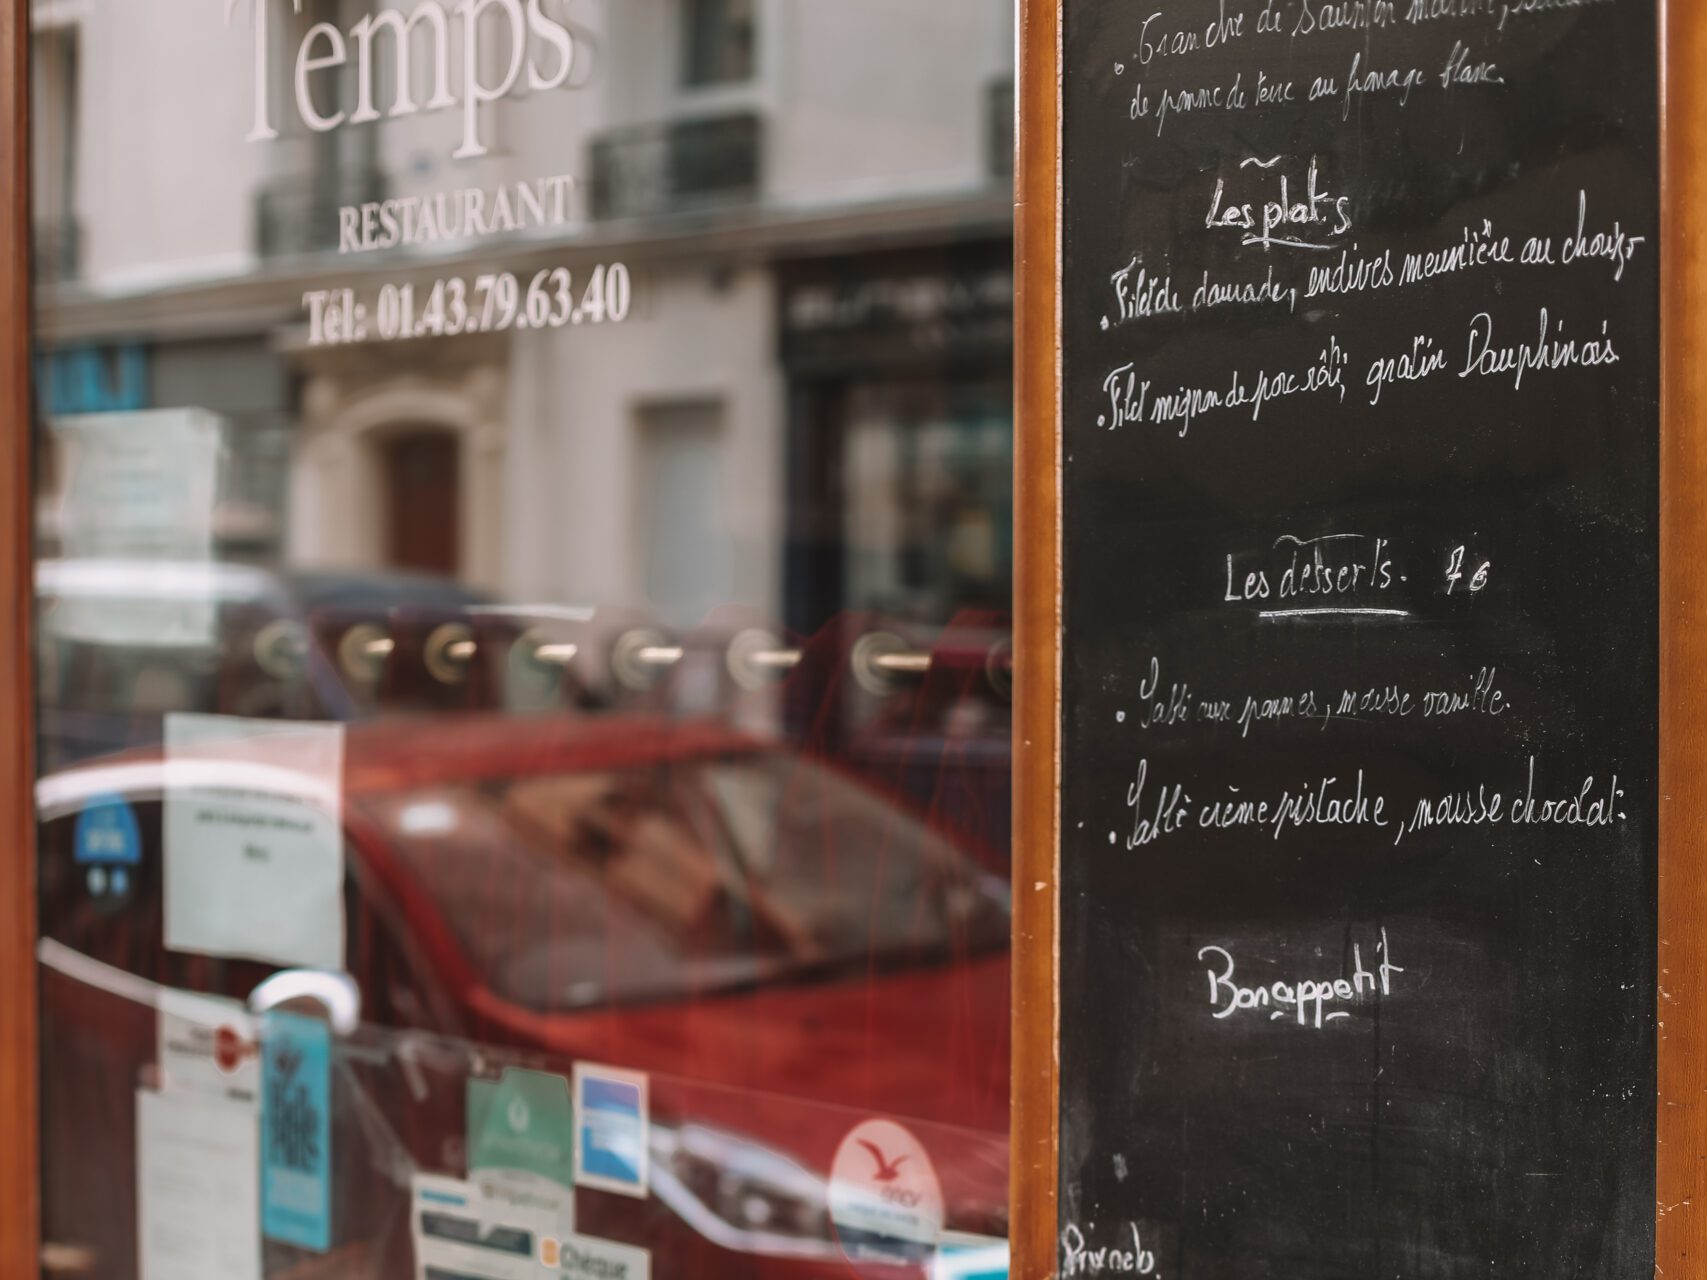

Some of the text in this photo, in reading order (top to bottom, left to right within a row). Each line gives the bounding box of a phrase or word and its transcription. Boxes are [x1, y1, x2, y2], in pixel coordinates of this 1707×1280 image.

[1256, 0, 1282, 33] de
[222, 0, 573, 159] Temps
[1130, 83, 1149, 120] de
[1226, 73, 1246, 110] de
[1308, 76, 1338, 101] au
[339, 174, 574, 254] RESTAURANT
[1205, 153, 1352, 251] Les plats
[377, 262, 631, 339] 01.43.79.63.40
[1304, 243, 1394, 297] endives
[1520, 237, 1555, 265] au
[1103, 362, 1150, 430] Filet
[1150, 386, 1222, 438] mignon
[1225, 370, 1249, 408] de
[1249, 370, 1300, 422] porc
[1366, 335, 1448, 406] gratin
[1224, 553, 1270, 601] Les
